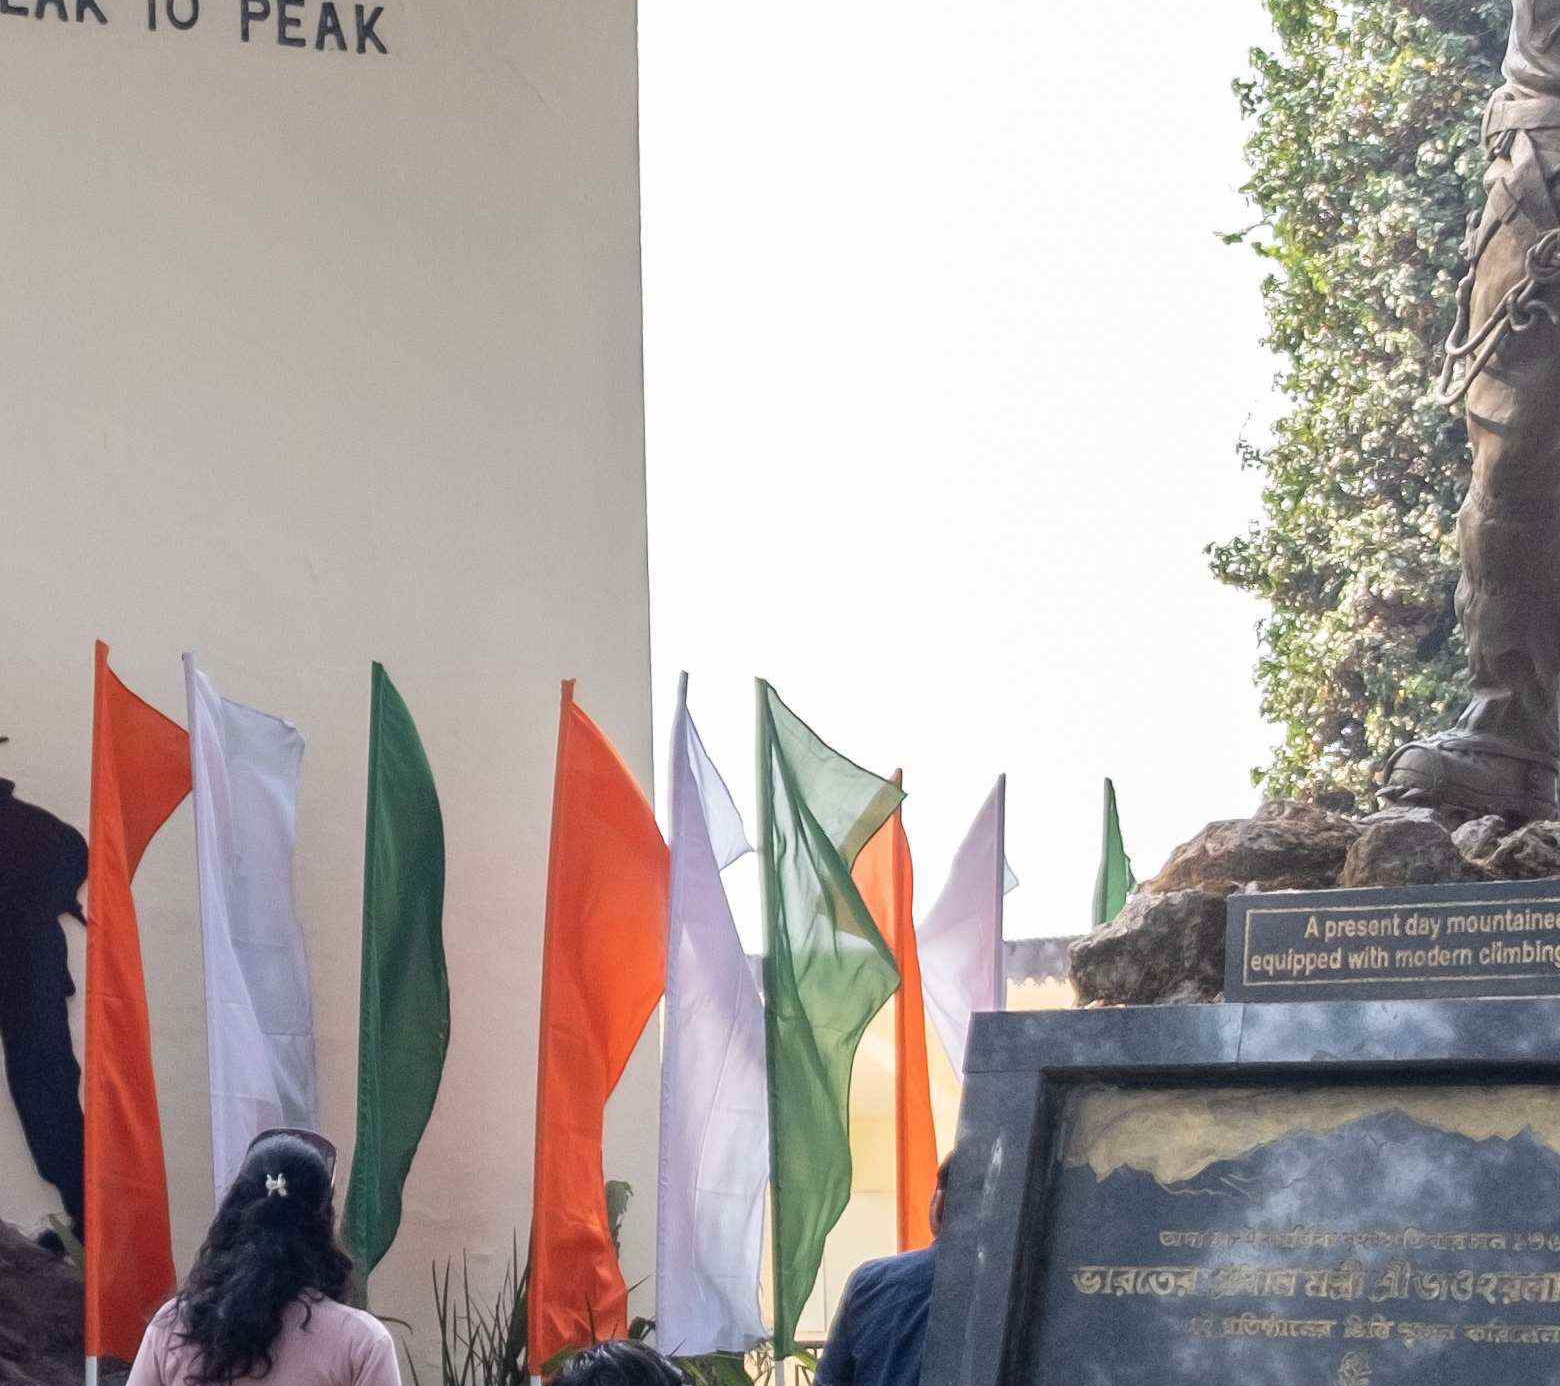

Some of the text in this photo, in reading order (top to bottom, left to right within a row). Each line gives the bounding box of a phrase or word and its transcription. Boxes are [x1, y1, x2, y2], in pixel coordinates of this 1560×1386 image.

[1304, 917, 1320, 941] A
[1324, 914, 1401, 945] present
[1404, 913, 1441, 941] day
[1250, 948, 1343, 980] equipped
[1347, 945, 1391, 971] with
[1395, 945, 1473, 969] modern
